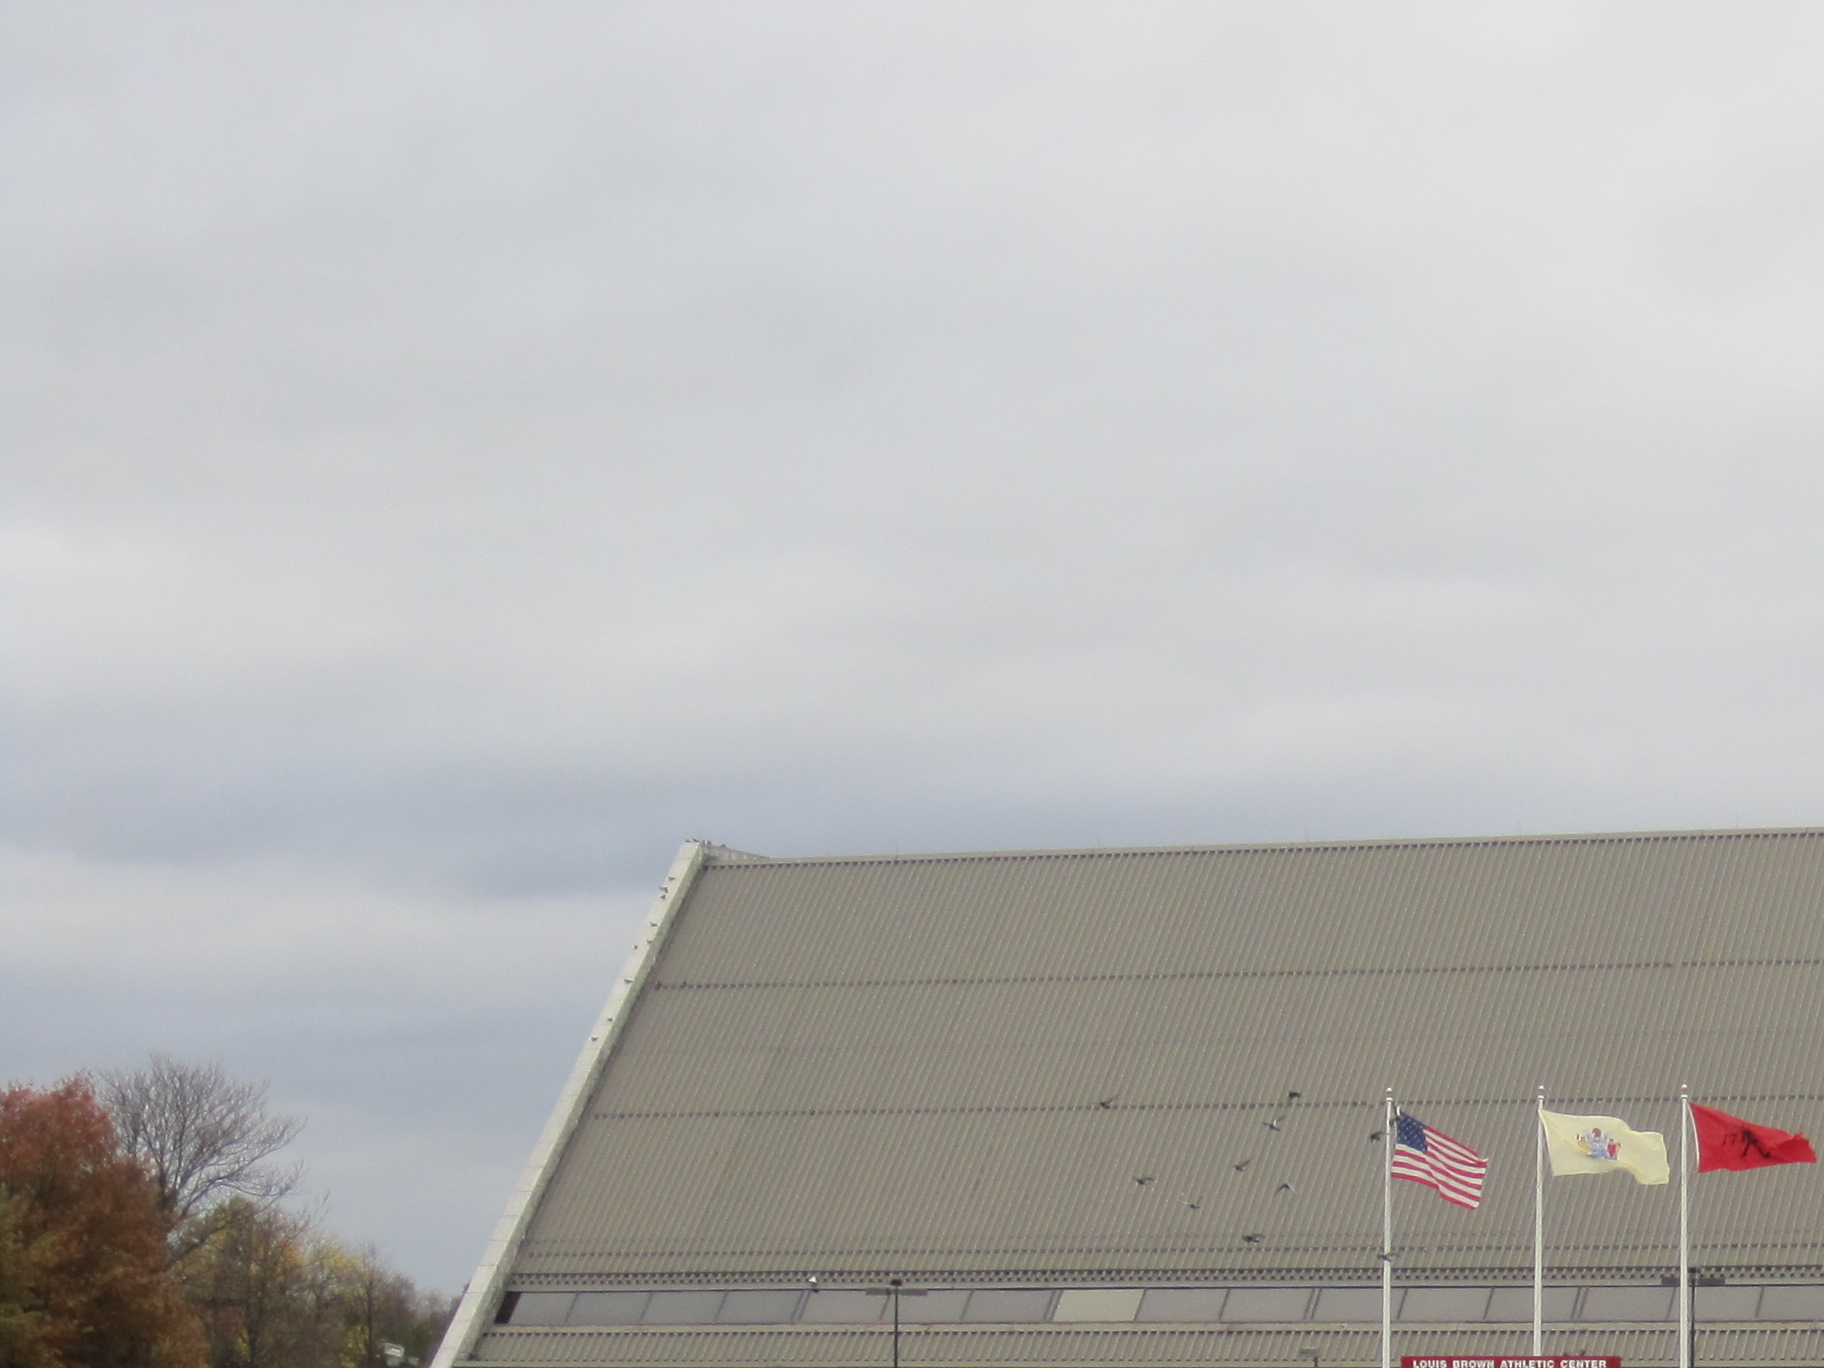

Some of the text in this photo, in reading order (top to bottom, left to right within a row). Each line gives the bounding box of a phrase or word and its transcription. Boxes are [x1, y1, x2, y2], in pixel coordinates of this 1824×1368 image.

[1412, 1360, 1607, 1368] LOUIS BROWN ATHLETIC CENTER
